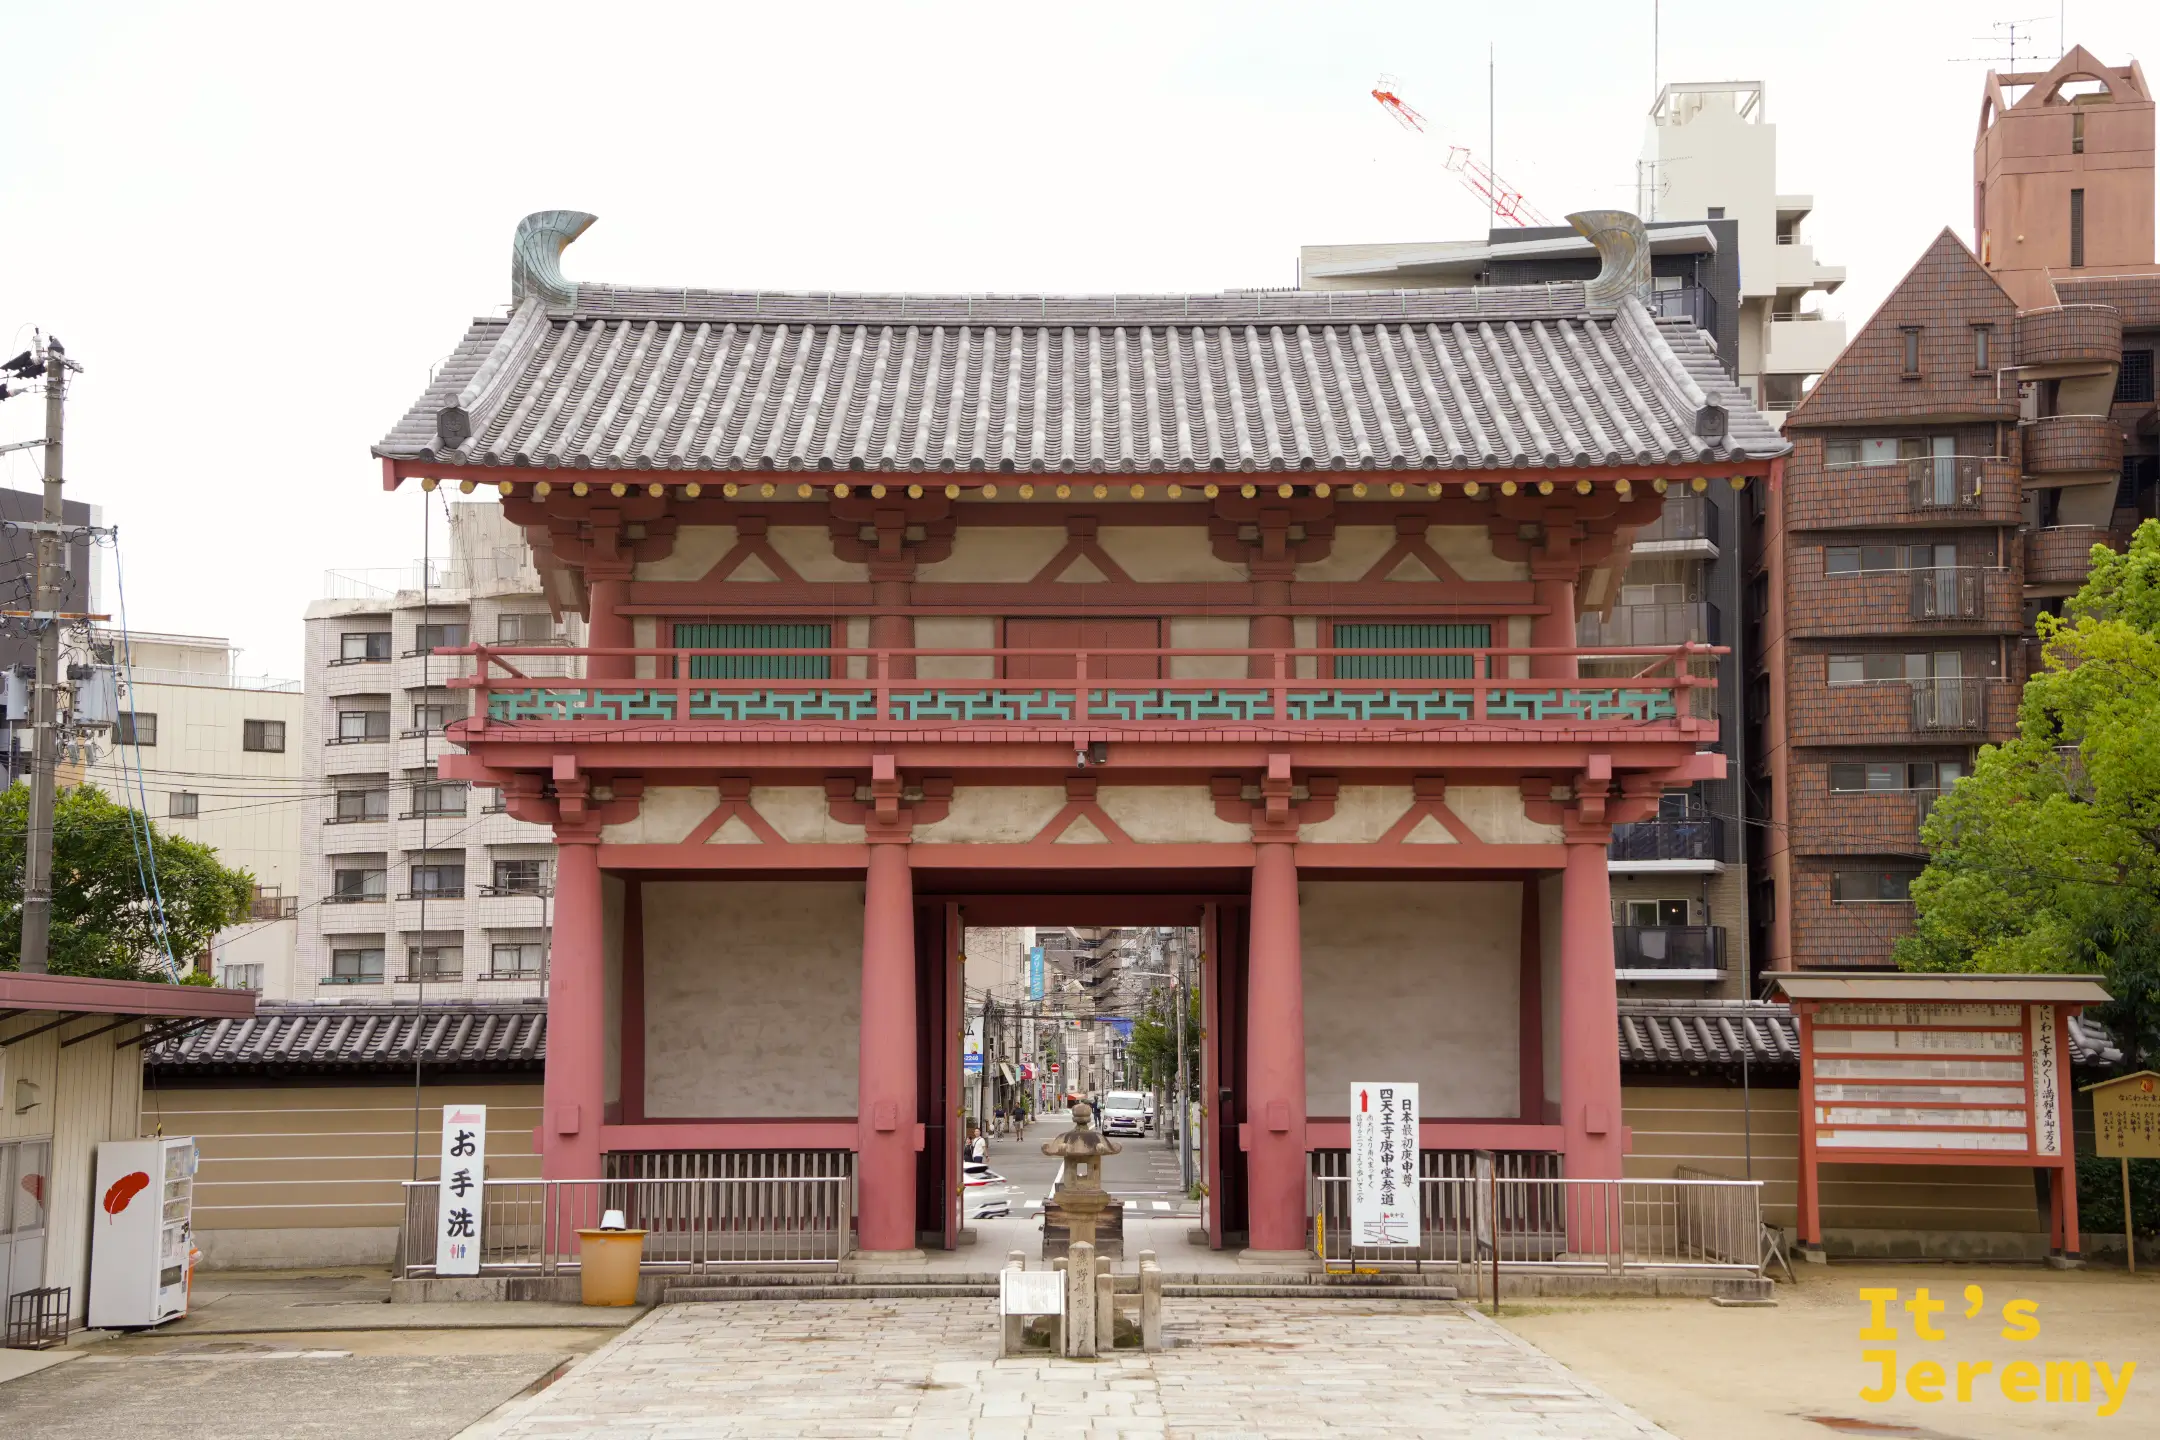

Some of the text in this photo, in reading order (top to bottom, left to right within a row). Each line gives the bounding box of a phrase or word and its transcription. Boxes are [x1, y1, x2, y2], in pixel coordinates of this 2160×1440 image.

[447, 1129, 476, 1238] お手洗
[1380, 1088, 1396, 1206] 四天王寺庚申堂参道
[1400, 1098, 1414, 1188] 日本最初庚申尊
